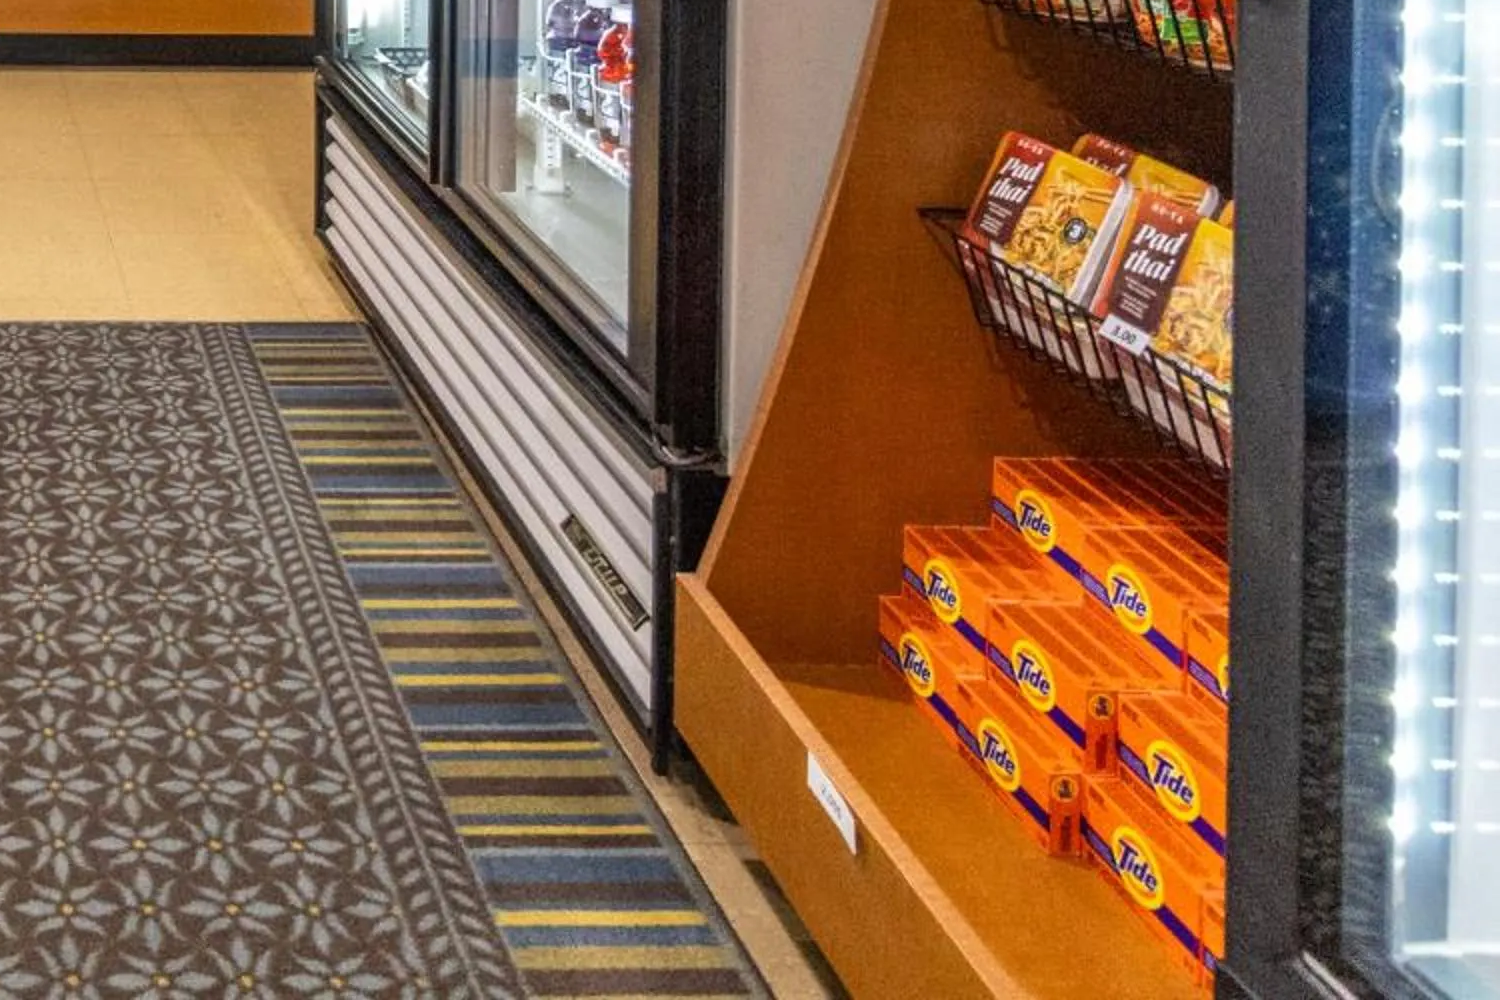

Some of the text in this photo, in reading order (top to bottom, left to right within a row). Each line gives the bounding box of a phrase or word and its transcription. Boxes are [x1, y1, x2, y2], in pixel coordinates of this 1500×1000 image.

[999, 157, 1045, 183] Pad
[988, 177, 1033, 203] thai
[1133, 223, 1188, 256] Pad
[1124, 249, 1176, 282] thai
[1019, 500, 1052, 537] Tide
[928, 569, 957, 608] Tide
[1112, 577, 1148, 617] Tide
[902, 641, 931, 682] Tide
[1017, 651, 1051, 696] Tide
[983, 729, 1016, 776] Tide
[1153, 753, 1194, 805] Tide
[1118, 838, 1158, 892] Tide
